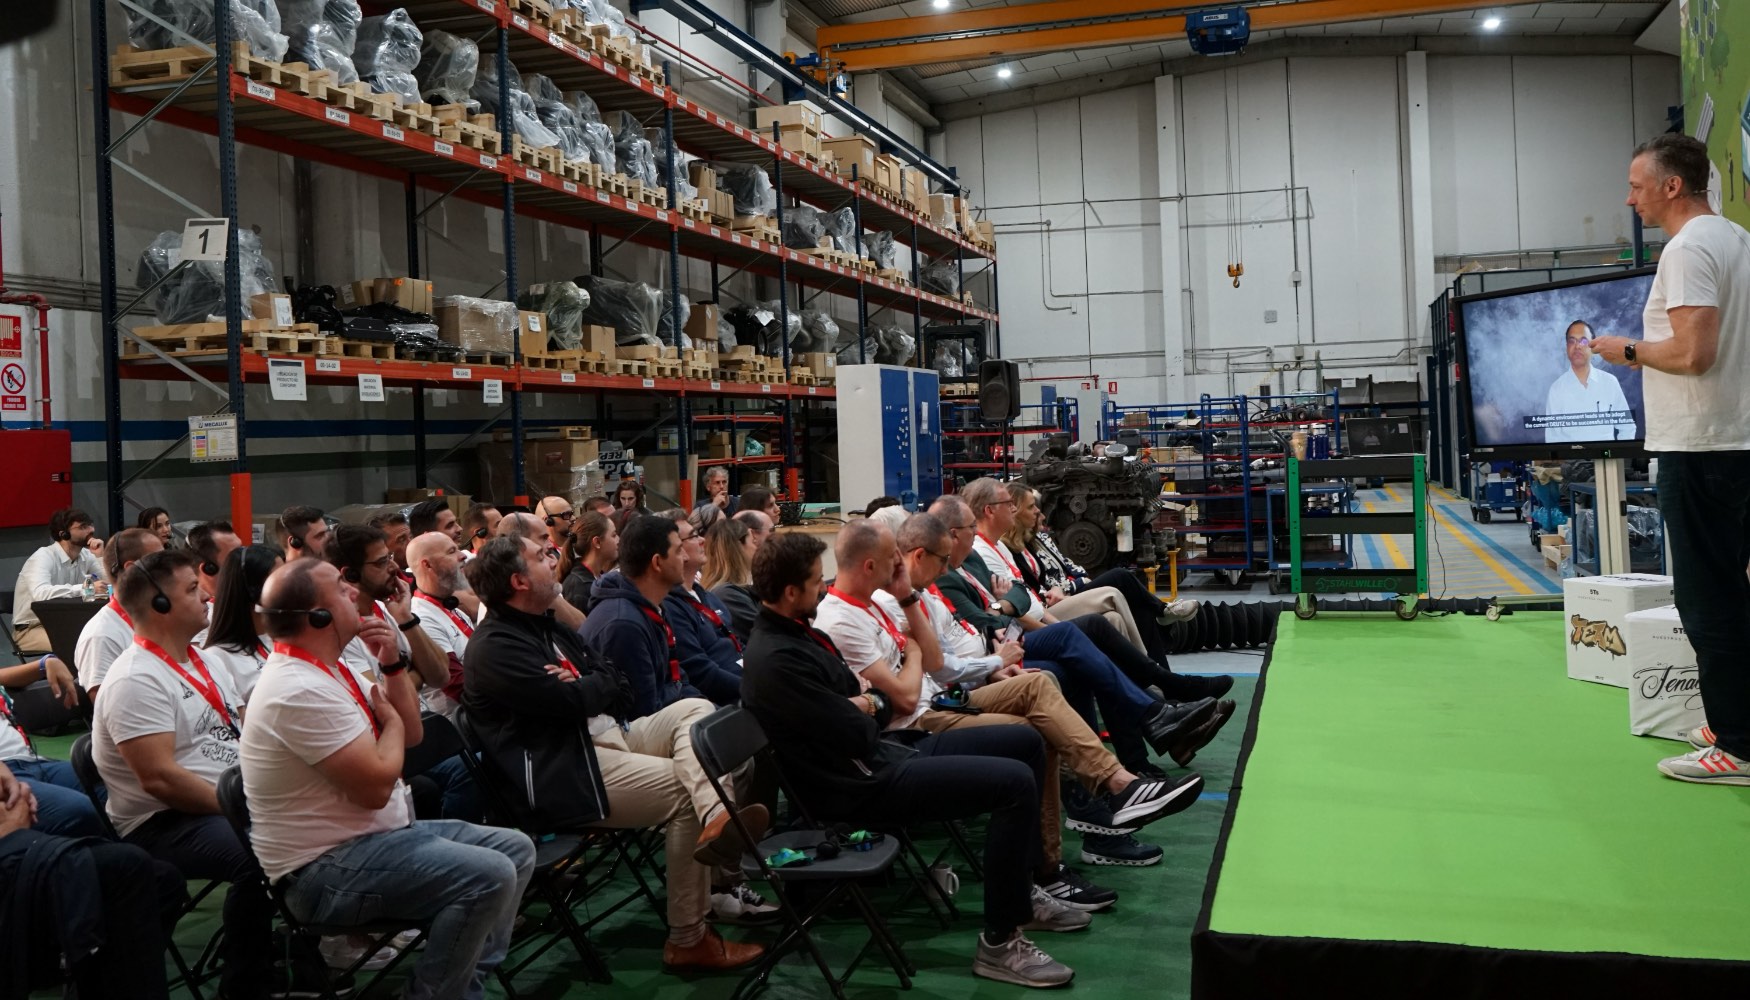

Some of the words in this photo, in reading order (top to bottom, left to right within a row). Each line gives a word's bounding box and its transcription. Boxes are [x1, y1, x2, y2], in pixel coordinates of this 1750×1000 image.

[198, 228, 210, 254] 1
[1330, 580, 1384, 588] STAHLWILLE
[1571, 614, 1626, 656] TEAM
